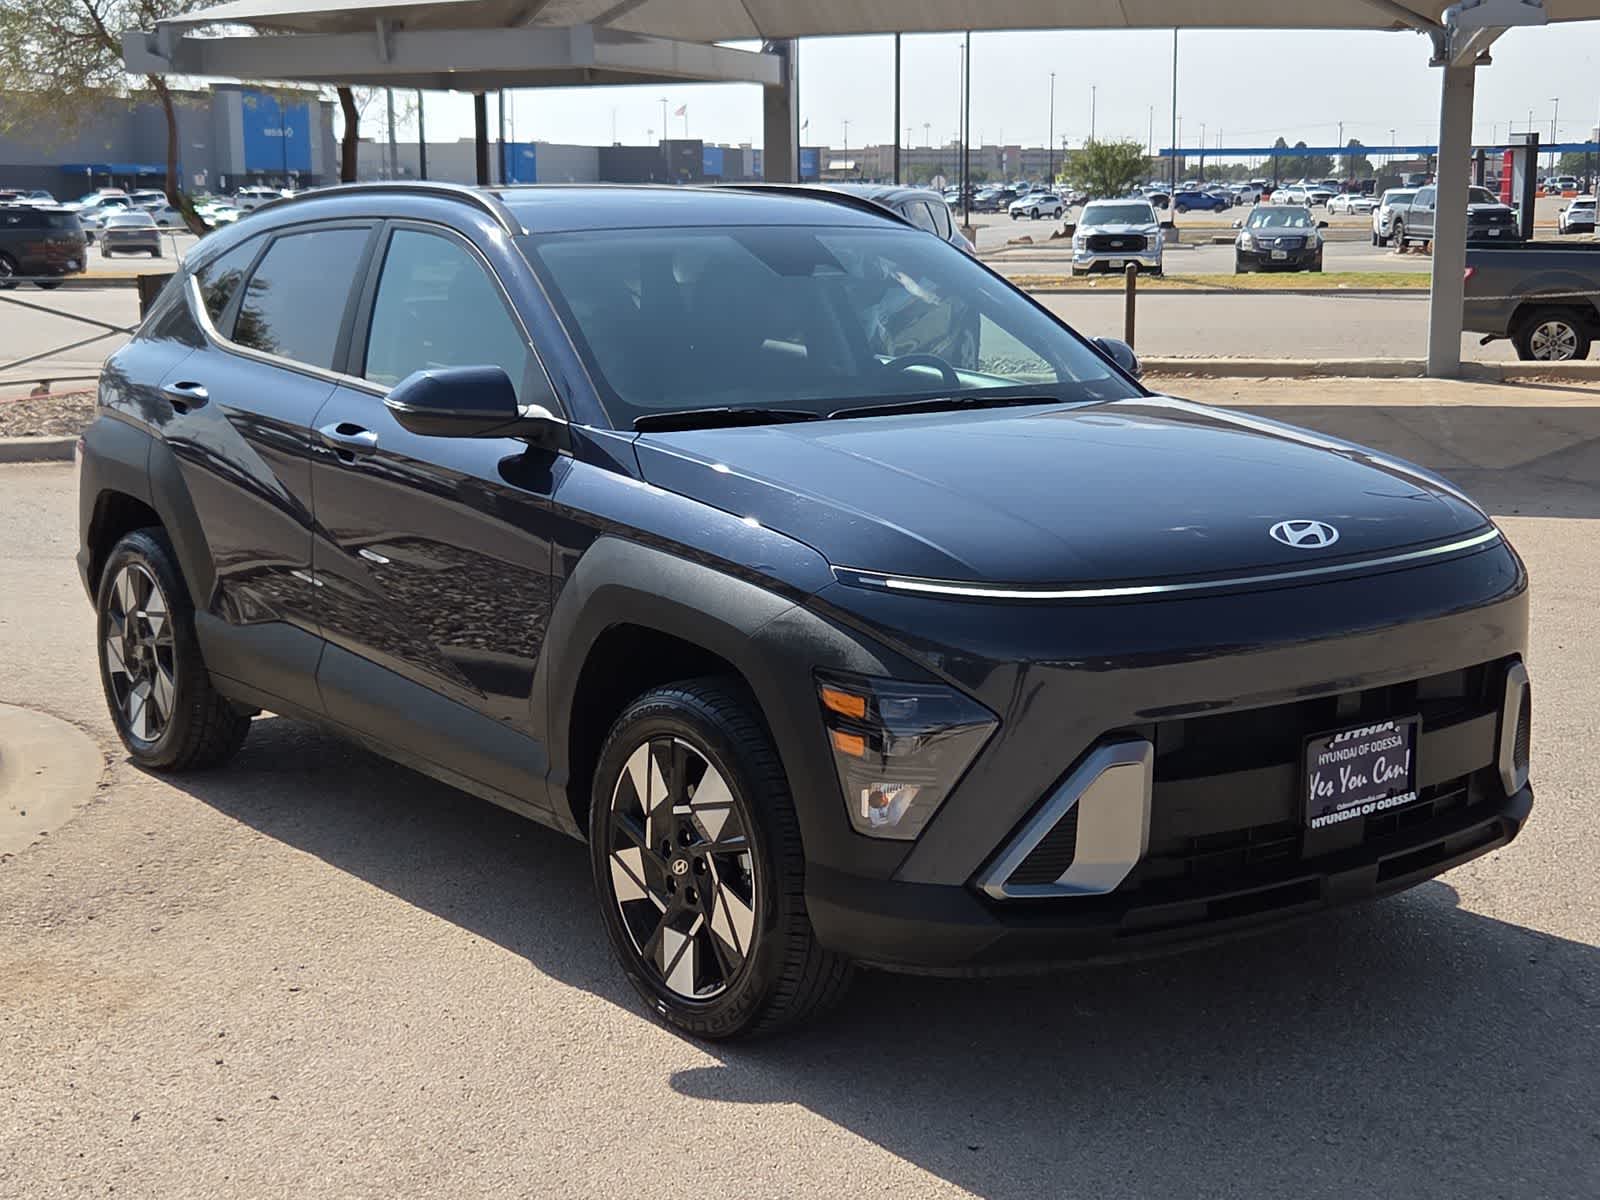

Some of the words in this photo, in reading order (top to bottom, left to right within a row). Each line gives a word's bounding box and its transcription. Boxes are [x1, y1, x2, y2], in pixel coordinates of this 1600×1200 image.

[1318, 746, 1358, 766] HYUNDAI
[1358, 743, 1370, 756] OF
[1370, 735, 1402, 753] ODESSA
[1309, 771, 1334, 801] Yes
[1339, 762, 1368, 793] You
[1372, 748, 1410, 784] Can!
[1311, 807, 1362, 829] HYUNDAI
[1361, 802, 1377, 815] OF
[1376, 791, 1417, 810] ODESSA
